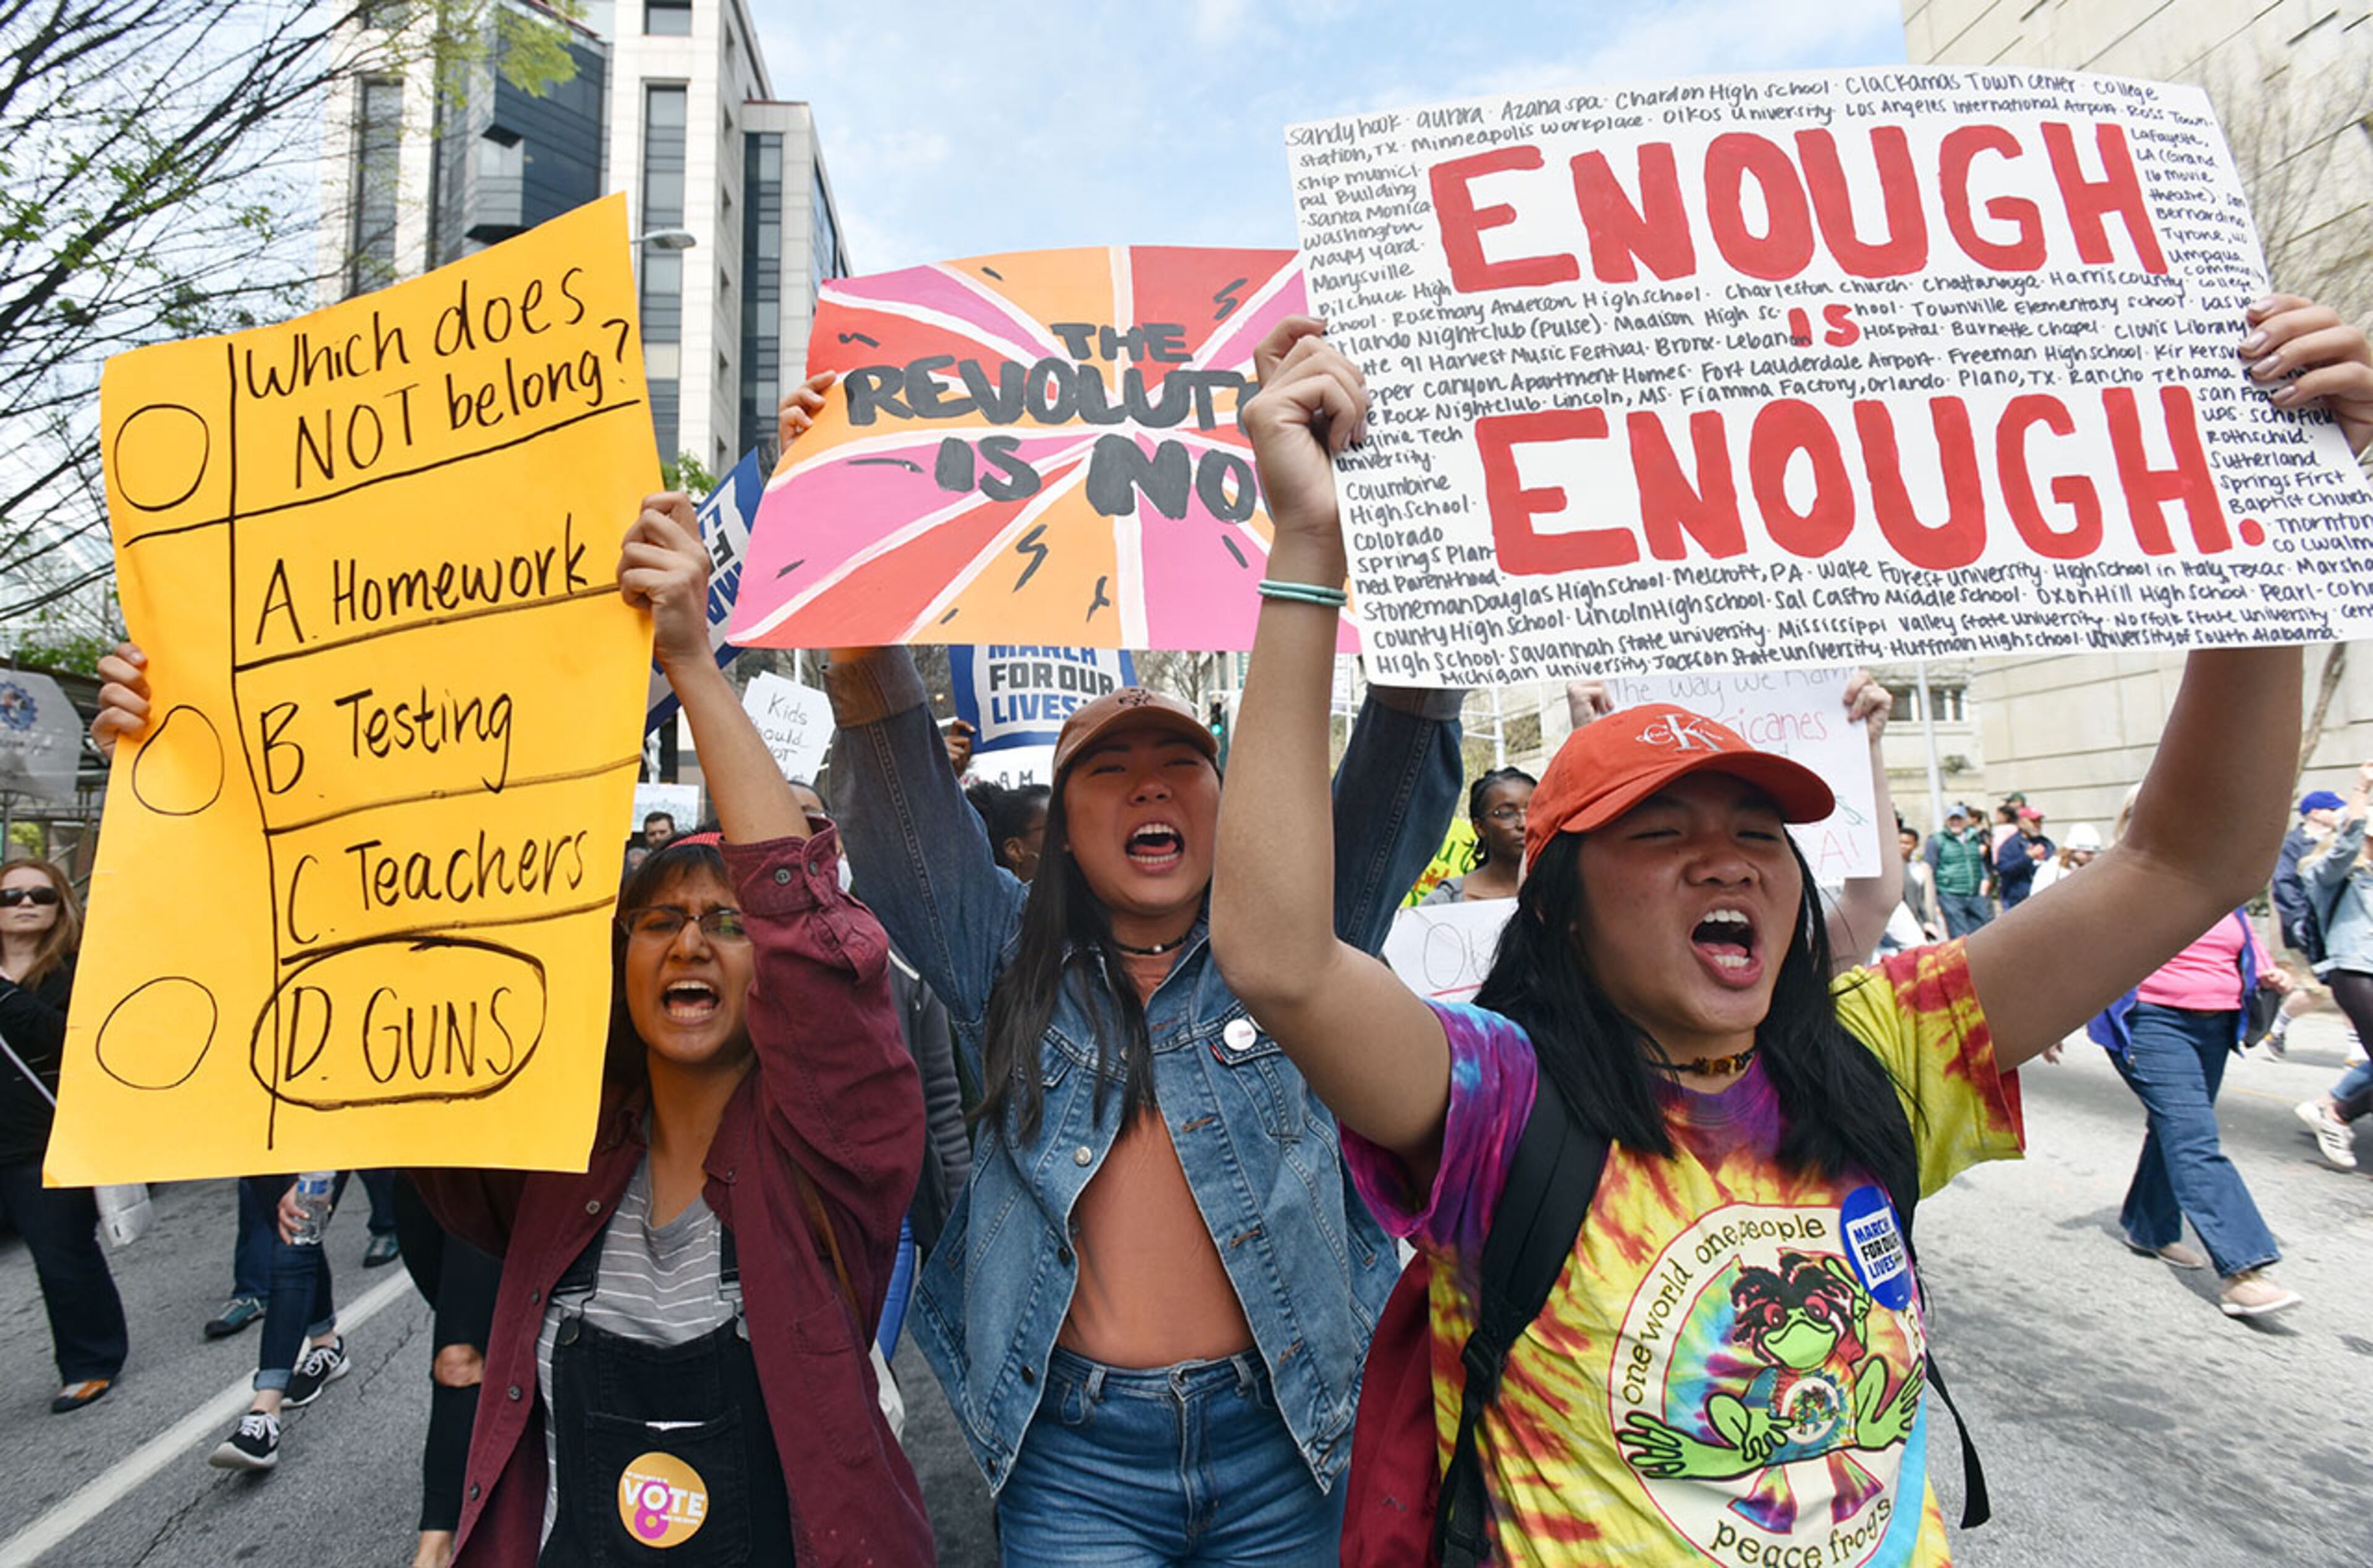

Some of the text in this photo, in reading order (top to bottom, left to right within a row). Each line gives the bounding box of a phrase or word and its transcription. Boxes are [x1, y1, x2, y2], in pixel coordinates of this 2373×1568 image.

[1502, 99, 1561, 120] Azana
[1565, 94, 1602, 113] spa
[1615, 83, 1705, 109] Chardon
[1709, 82, 1758, 107] High
[1965, 72, 2023, 91] Town
[1374, 141, 1398, 156] TX
[1411, 125, 1534, 153] Minneapolis
[1845, 101, 1876, 117] Los
[1881, 97, 1945, 118] Angeles
[1953, 95, 2059, 114] International
[1299, 182, 1418, 210] pal Building
[1366, 200, 1432, 221] Monica
[1429, 122, 2168, 293] ENOUGH
[1309, 247, 1365, 271] Navy
[1312, 261, 1415, 294] Marysville
[1318, 280, 1452, 318] Pilchuck High
[1392, 303, 1484, 328] Rosemary
[1725, 282, 1834, 301] Charleston
[246, 267, 586, 399] Which does
[1050, 321, 1194, 363] THE
[1417, 318, 1526, 350] Nightclub
[1531, 312, 1604, 339] (Pulse)
[1614, 310, 1694, 332] Madison
[1704, 306, 1750, 329] High
[1912, 295, 2008, 318] Townville
[1788, 303, 1860, 347] IS
[1401, 355, 1423, 373] 91
[1429, 348, 1507, 371] Harvest
[1511, 342, 1567, 363] Music
[1570, 337, 1645, 361] Festival
[1655, 334, 1714, 356] Bronx
[1725, 331, 1813, 350] Lebanon
[1863, 322, 1938, 341] Hospital
[2114, 320, 2167, 339] Clovis
[2174, 319, 2248, 339] Library
[1510, 369, 1619, 393] Apartment
[1622, 365, 1688, 384] Homes
[1701, 361, 1745, 381] Fort
[1750, 354, 1863, 376] Lauderdale
[1947, 347, 2037, 366] Freeman
[295, 318, 631, 490] NOT belong?
[843, 354, 1259, 439] REVOLUT
[1384, 408, 1430, 426] Rock
[1436, 398, 1541, 426] Nightclub
[1638, 387, 1667, 405] MS
[1680, 382, 1774, 405] Fiamma
[2028, 370, 2057, 385] TX
[2069, 367, 2143, 386] Rancho
[1417, 426, 1463, 444] Tech
[934, 435, 1043, 502] IS
[1086, 434, 1275, 525] NO
[1345, 475, 1451, 502] Columbine
[1475, 386, 2265, 576] ENOUGH.
[2295, 470, 2345, 487] First
[1350, 503, 1403, 527] High
[1353, 526, 1444, 550] Colorado
[332, 512, 588, 626] Homework
[1355, 575, 1392, 594] ned
[1770, 562, 1803, 583] PA
[1817, 560, 1872, 580] Wake
[1877, 560, 1943, 587] Forest
[2157, 563, 2176, 576] in
[1450, 585, 2185, 645] High Sal Castro Middle High
[988, 645, 1098, 666] MARCH
[1376, 651, 1430, 678] High
[1509, 636, 1614, 665] Savannah
[1618, 632, 1669, 653] State
[1778, 618, 1886, 639] Mississippi
[1898, 613, 1957, 636] Valley
[1960, 611, 2008, 630] State
[1440, 665, 1539, 686] Michigan
[1978, 630, 2024, 651] High
[989, 663, 1115, 697] FOR OUR
[768, 693, 809, 726] Kids
[1723, 708, 1827, 744] icanes
[333, 685, 514, 794] Testing
[345, 829, 588, 913] Teachers
[362, 987, 515, 1083] GUNS
[1854, 1216, 1890, 1244] MARCH
[1861, 1239, 1884, 1262] FOR
[1868, 1255, 1896, 1279] LIVES
[1622, 1342, 1652, 1406] one
[1640, 1257, 1693, 1342] world
[1694, 1224, 1738, 1265] one
[623, 1478, 705, 1517] VOTE
